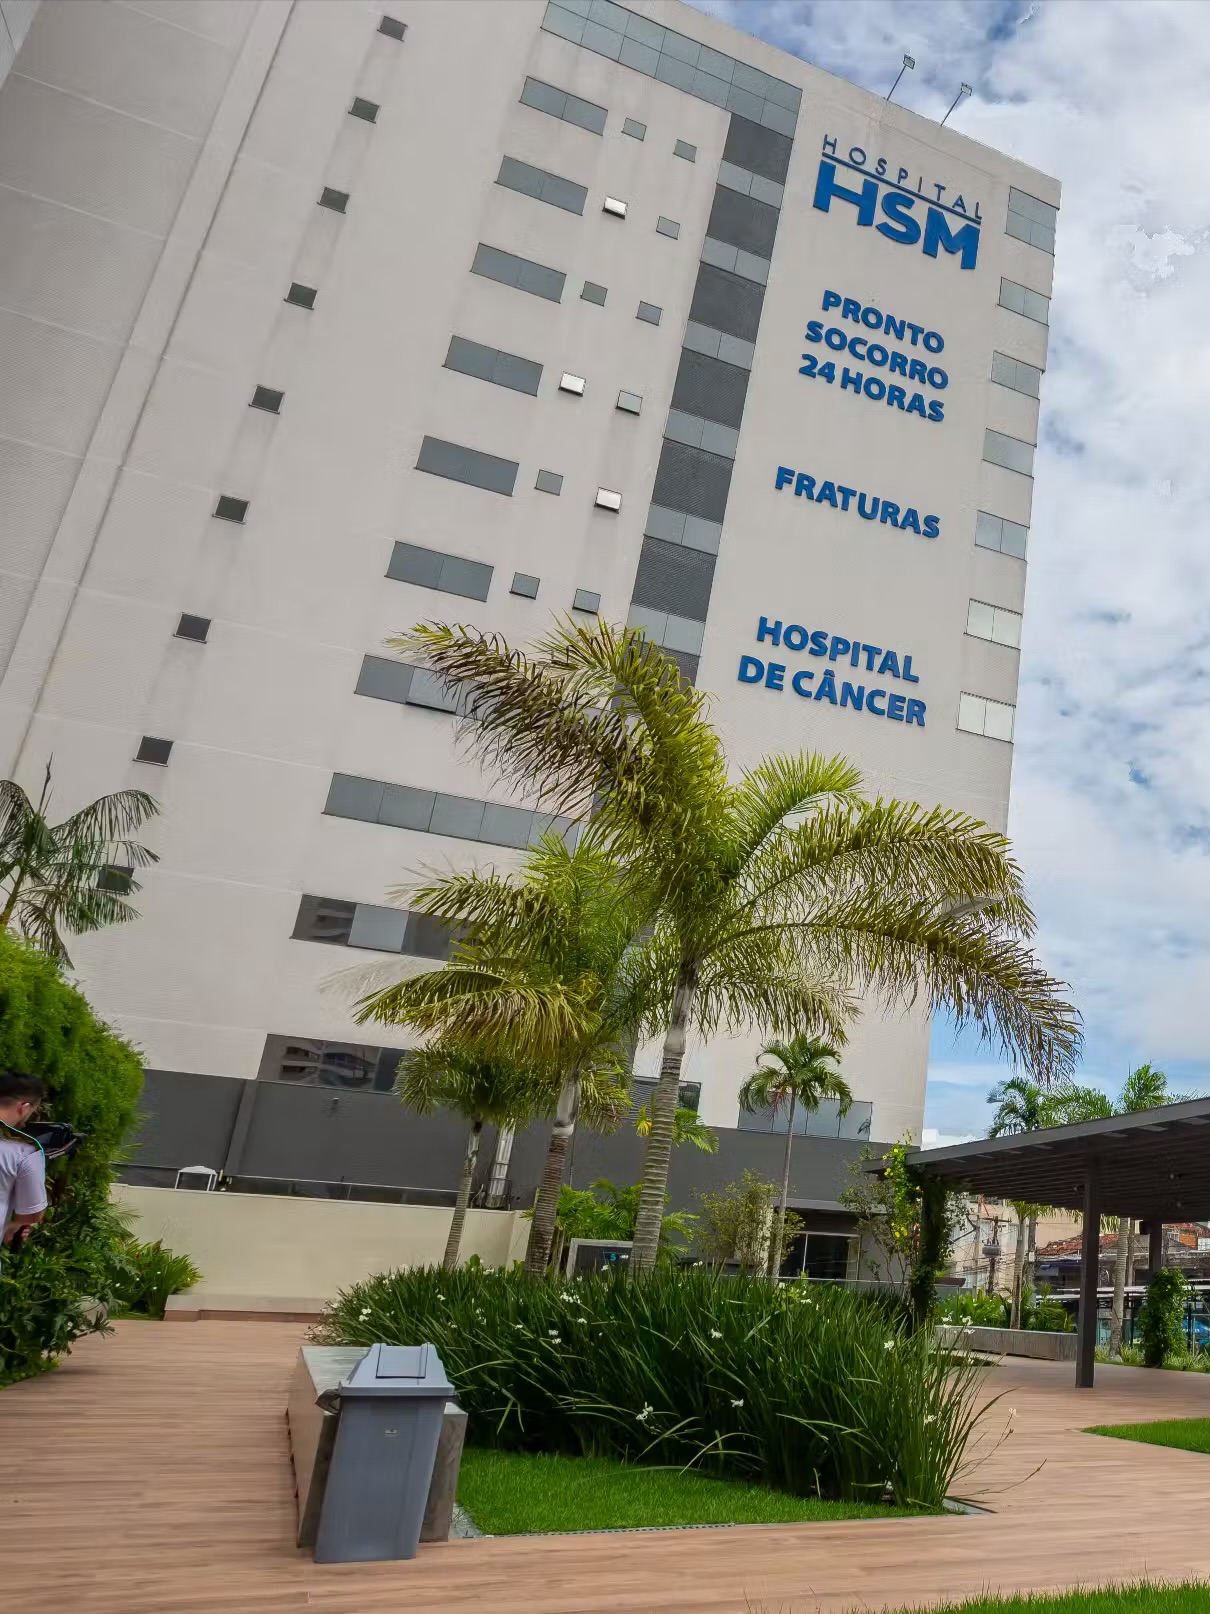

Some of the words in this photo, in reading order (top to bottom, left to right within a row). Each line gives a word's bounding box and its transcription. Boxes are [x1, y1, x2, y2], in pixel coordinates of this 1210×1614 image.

[822, 134, 982, 220] HOSPITAL
[813, 159, 980, 269] HSM
[805, 320, 949, 390] SOCORRO
[821, 289, 945, 353] PRONTO
[799, 353, 836, 383] 24
[840, 367, 945, 422] HORAS
[774, 465, 941, 539] FRATURAS
[756, 615, 919, 683] HOSPITAL
[737, 655, 786, 691] DE
[791, 668, 927, 727] CÂNCER
